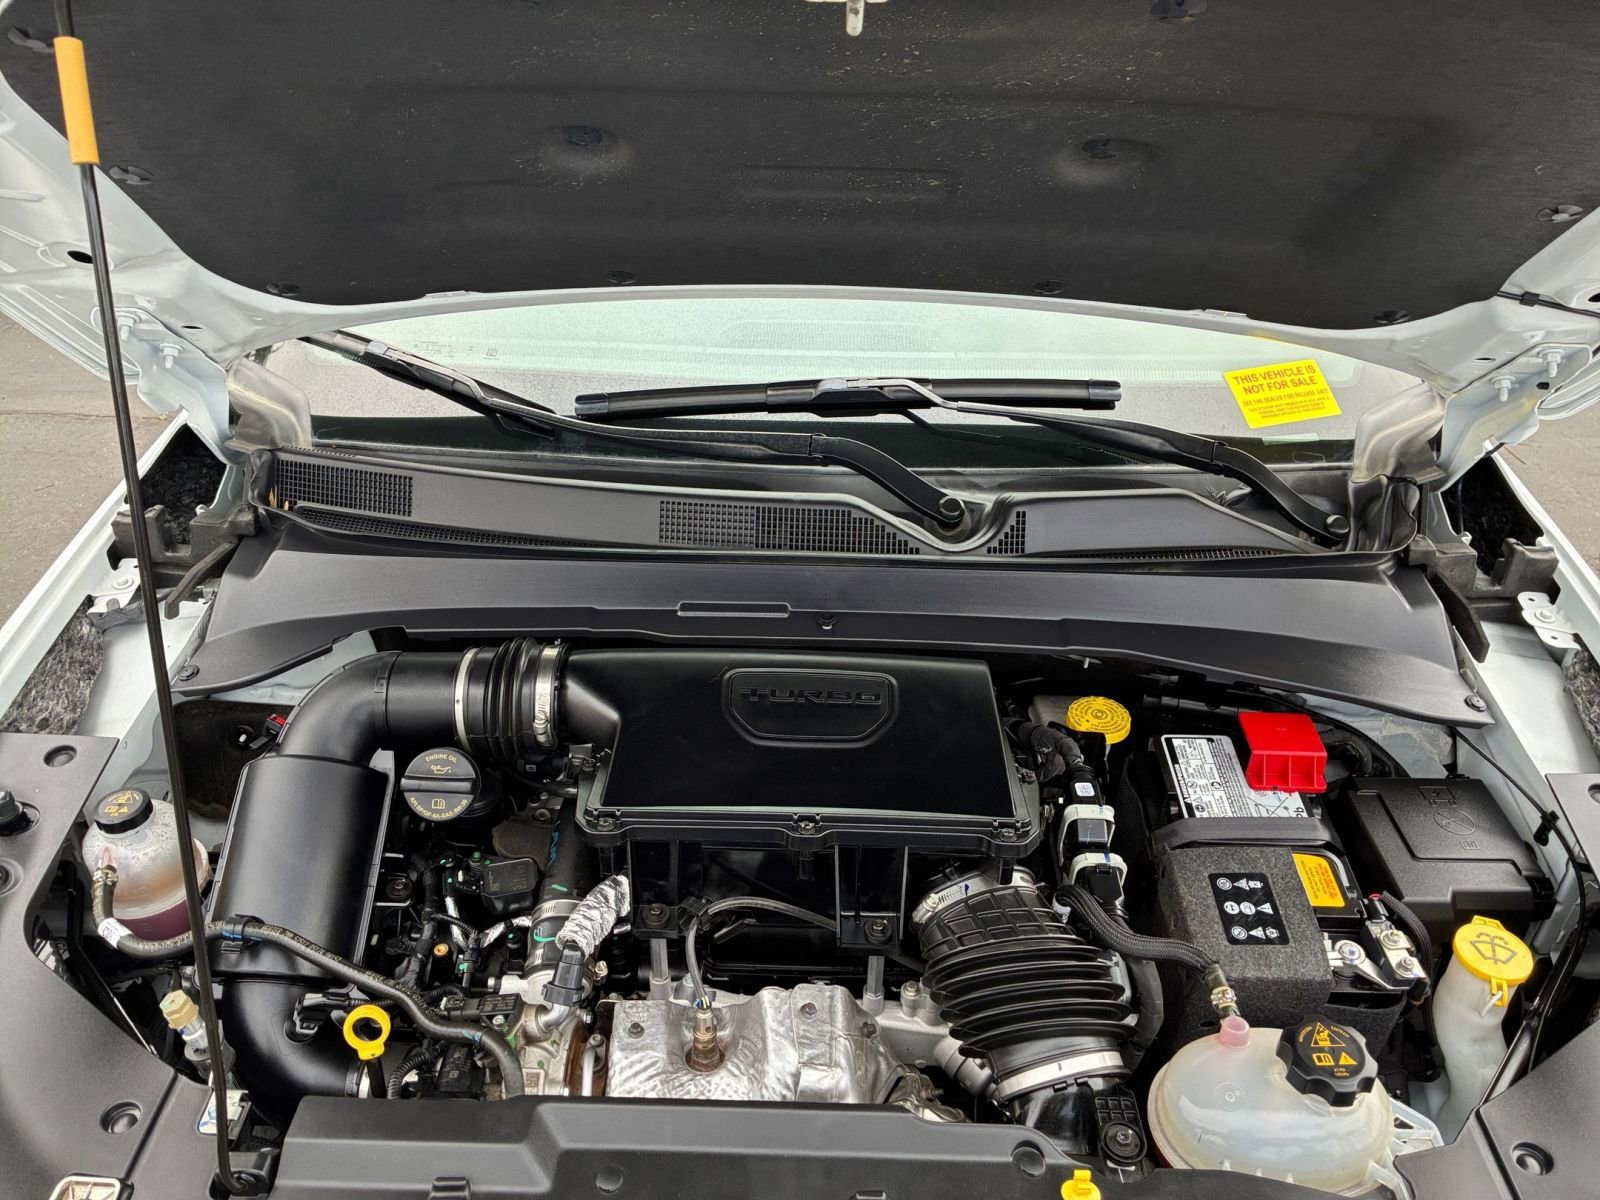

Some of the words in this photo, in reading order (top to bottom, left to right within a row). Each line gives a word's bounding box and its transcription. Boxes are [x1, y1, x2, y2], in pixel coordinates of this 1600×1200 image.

[1233, 373, 1259, 385] THIS
[1260, 366, 1304, 381] VEHICLE
[1305, 364, 1316, 374] IS
[1243, 383, 1266, 395] NOT
[1268, 379, 1289, 391] FOR
[1291, 376, 1317, 388] SALE
[1264, 395, 1283, 404] DEALER
[1284, 392, 1294, 400] FOR
[740, 688, 882, 705] TURBO
[425, 753, 448, 762] ENGINE
[448, 754, 457, 764] OIL
